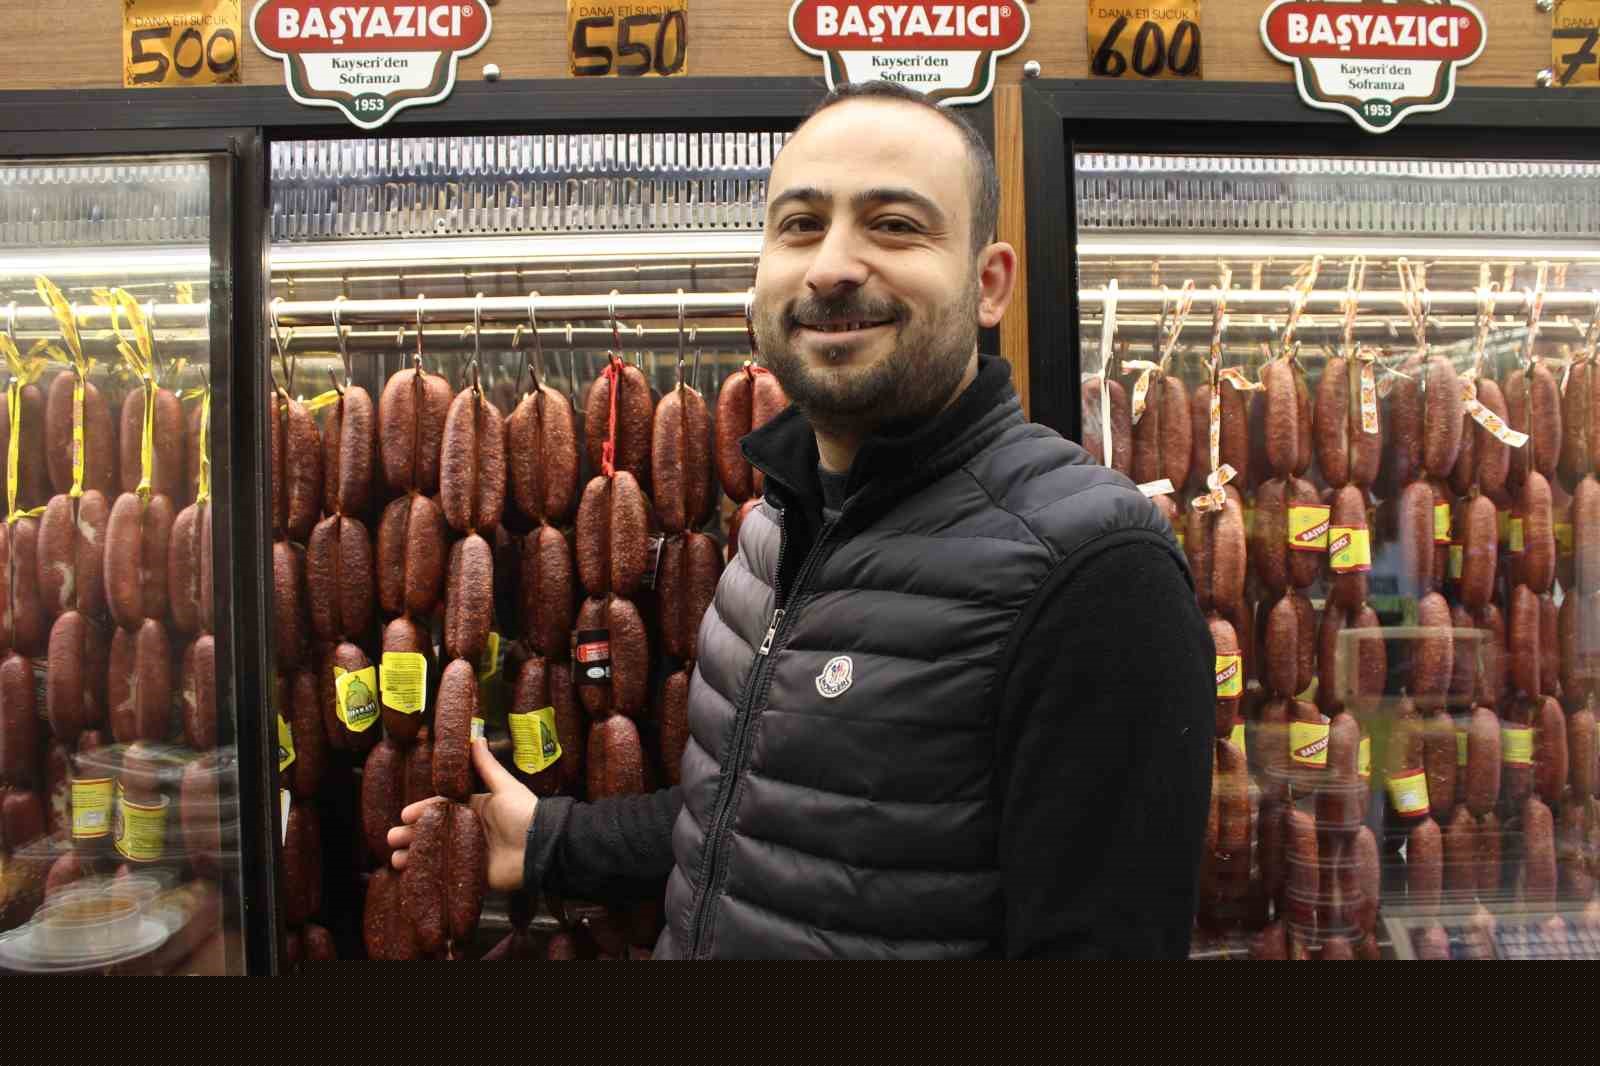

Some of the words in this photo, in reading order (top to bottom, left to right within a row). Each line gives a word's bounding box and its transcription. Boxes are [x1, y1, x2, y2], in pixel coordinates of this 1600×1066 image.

[579, 6, 615, 17] DANA
[1098, 8, 1132, 18] DANA
[1152, 8, 1189, 19] SUCUK
[573, 10, 687, 76] 550
[1091, 15, 1202, 77] 600
[131, 26, 237, 83] 500
[1552, 27, 1600, 87] 7
[331, 57, 409, 71] Kayseri'den
[871, 55, 949, 69] Kayseri'den
[1340, 63, 1412, 77] Kayseri'den
[354, 98, 385, 112] 1953
[1363, 104, 1392, 117] 1953
